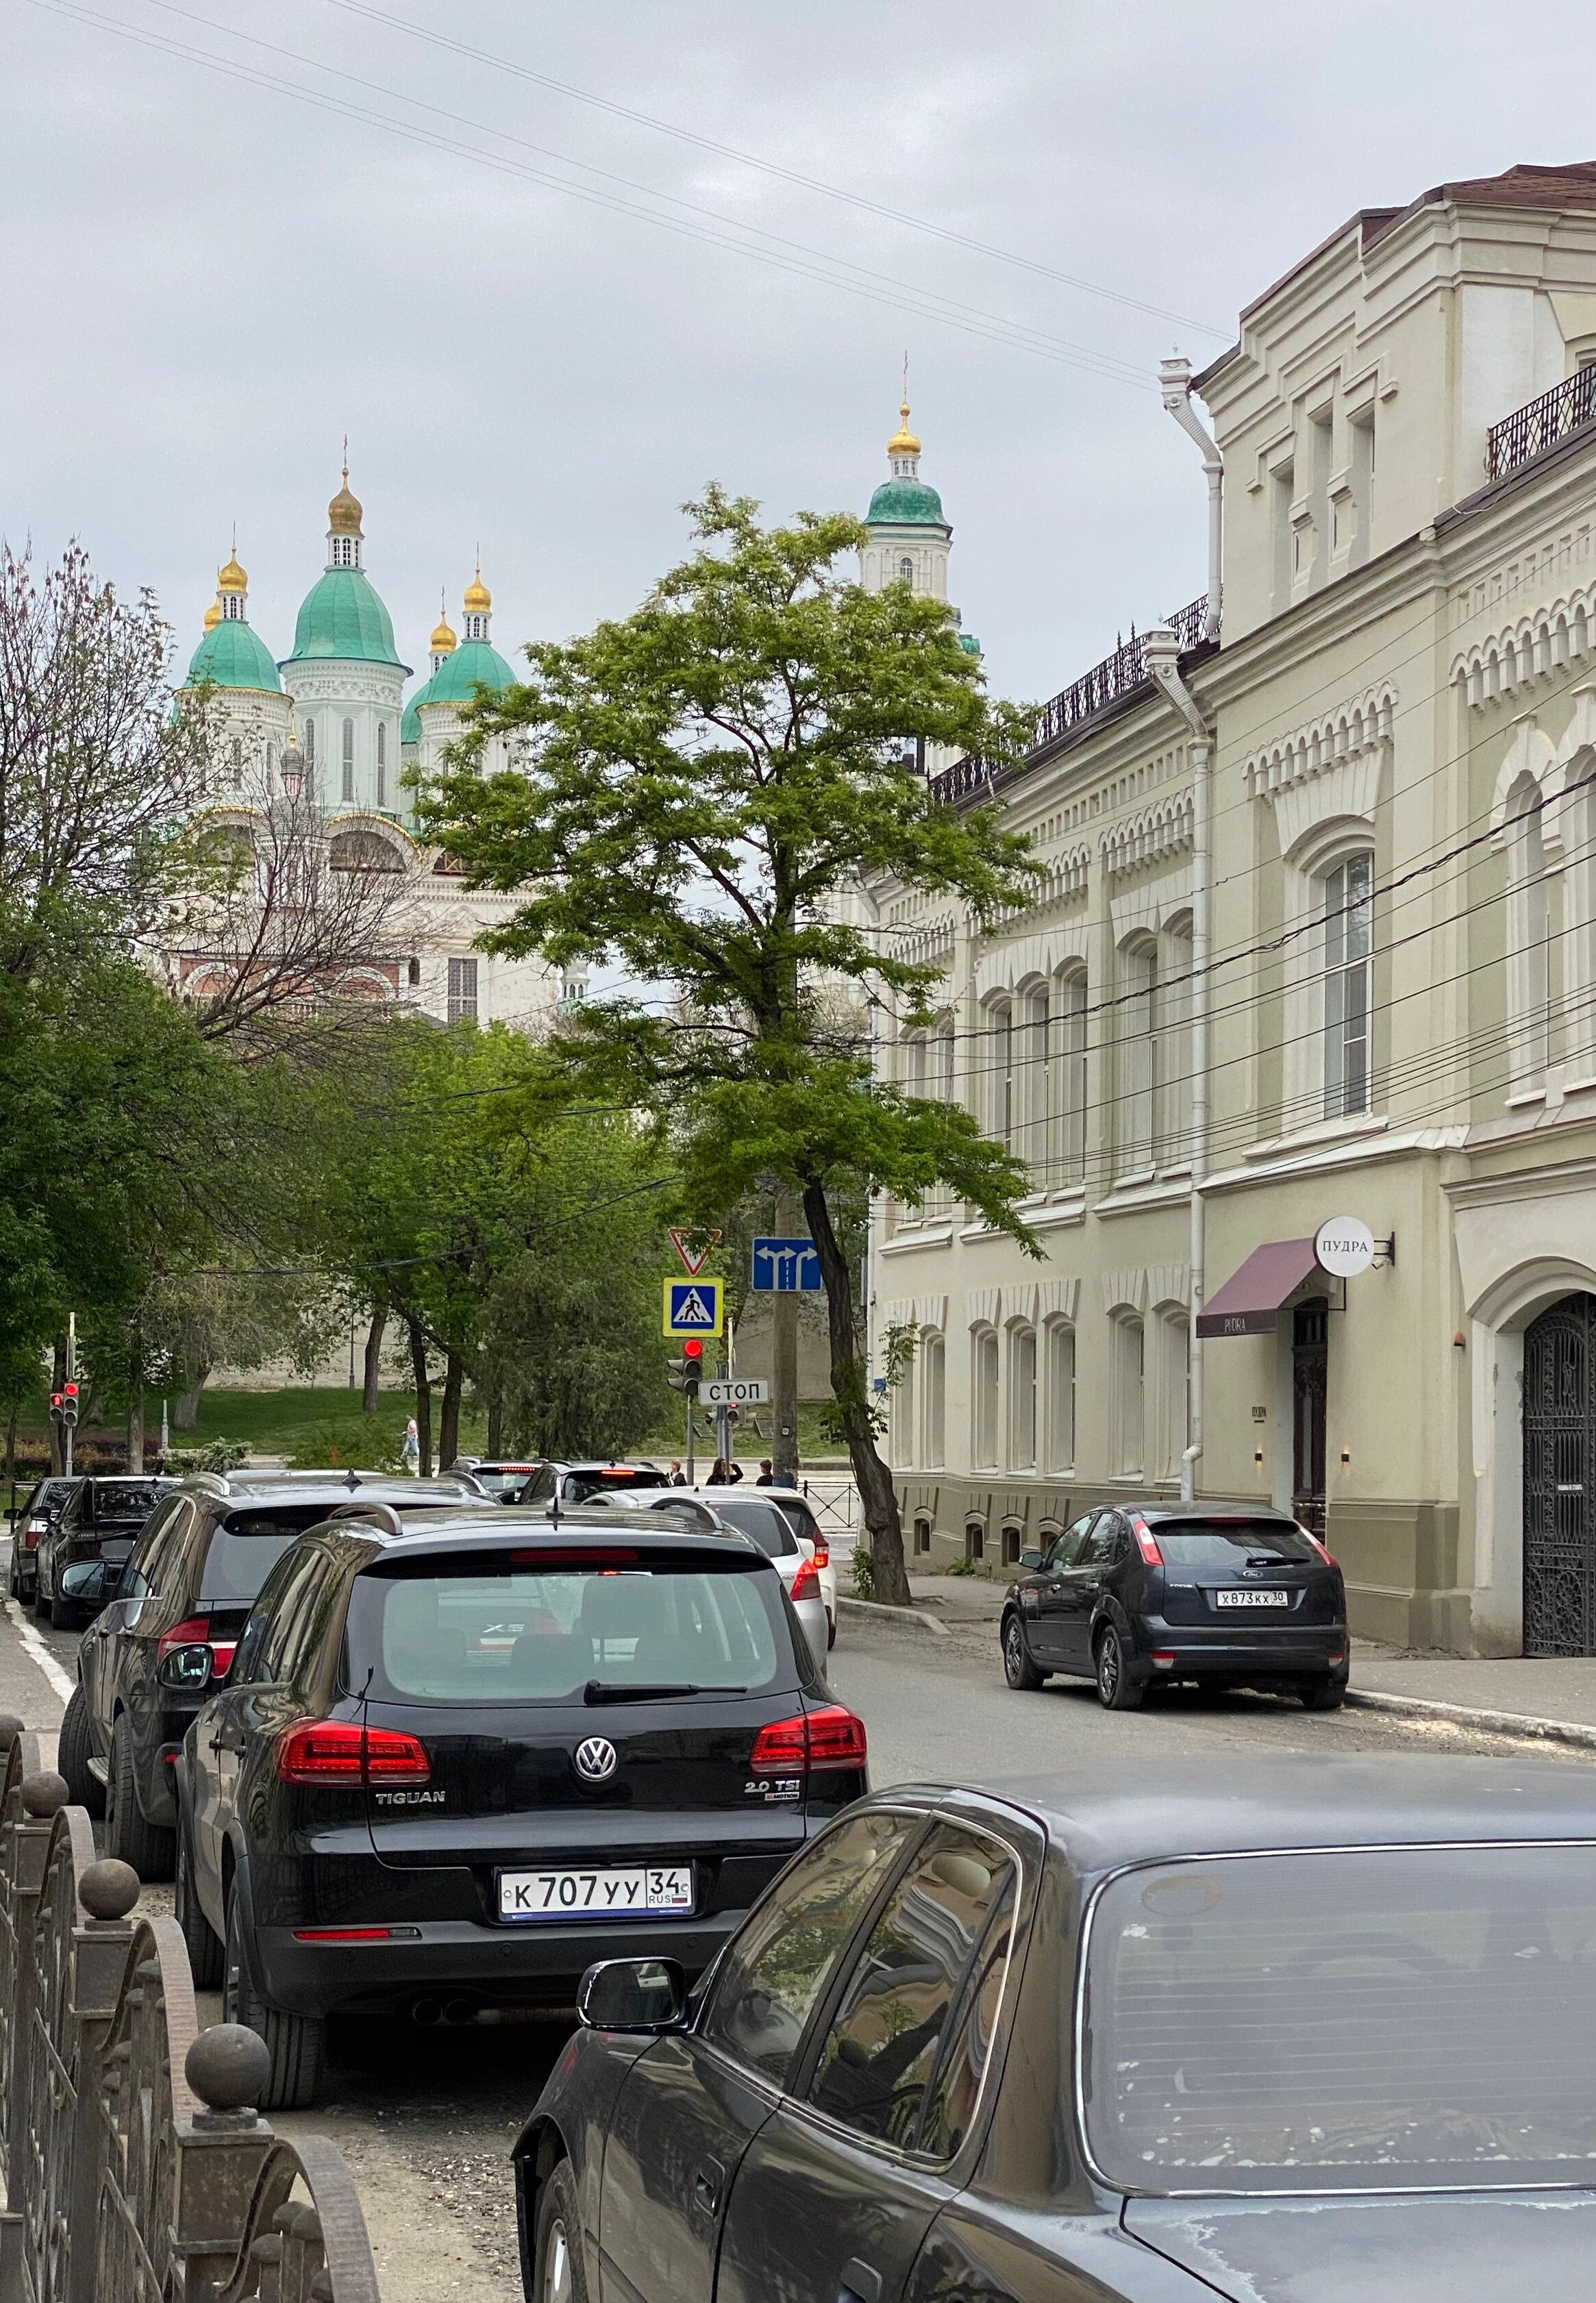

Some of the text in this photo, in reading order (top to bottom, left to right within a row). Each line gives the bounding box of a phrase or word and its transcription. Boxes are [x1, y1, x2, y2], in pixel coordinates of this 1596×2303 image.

[1323, 1241, 1368, 1254] ПУДРА
[710, 1384, 760, 1401] СТОП
[1273, 1592, 1283, 1601] 30
[744, 1780, 800, 1793] 2.0 TSI
[375, 1791, 446, 1805] TIGUAN
[650, 1871, 679, 1895] 34
[649, 1895, 671, 1904] RUS
